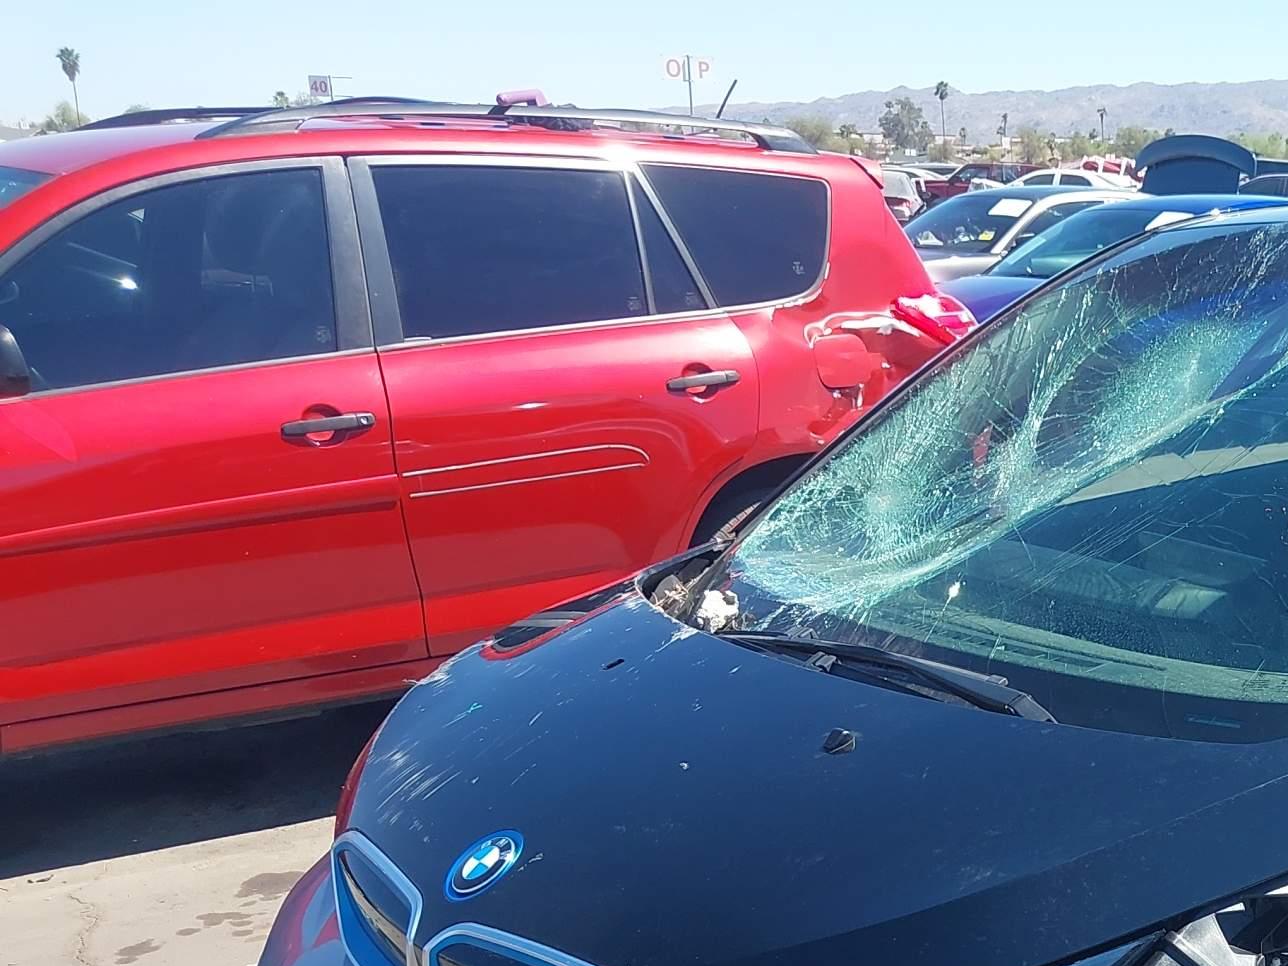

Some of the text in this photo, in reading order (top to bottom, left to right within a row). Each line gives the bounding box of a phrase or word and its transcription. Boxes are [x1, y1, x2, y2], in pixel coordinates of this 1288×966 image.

[666, 58, 681, 78] O
[698, 61, 710, 79] P
[310, 80, 328, 93] 40
